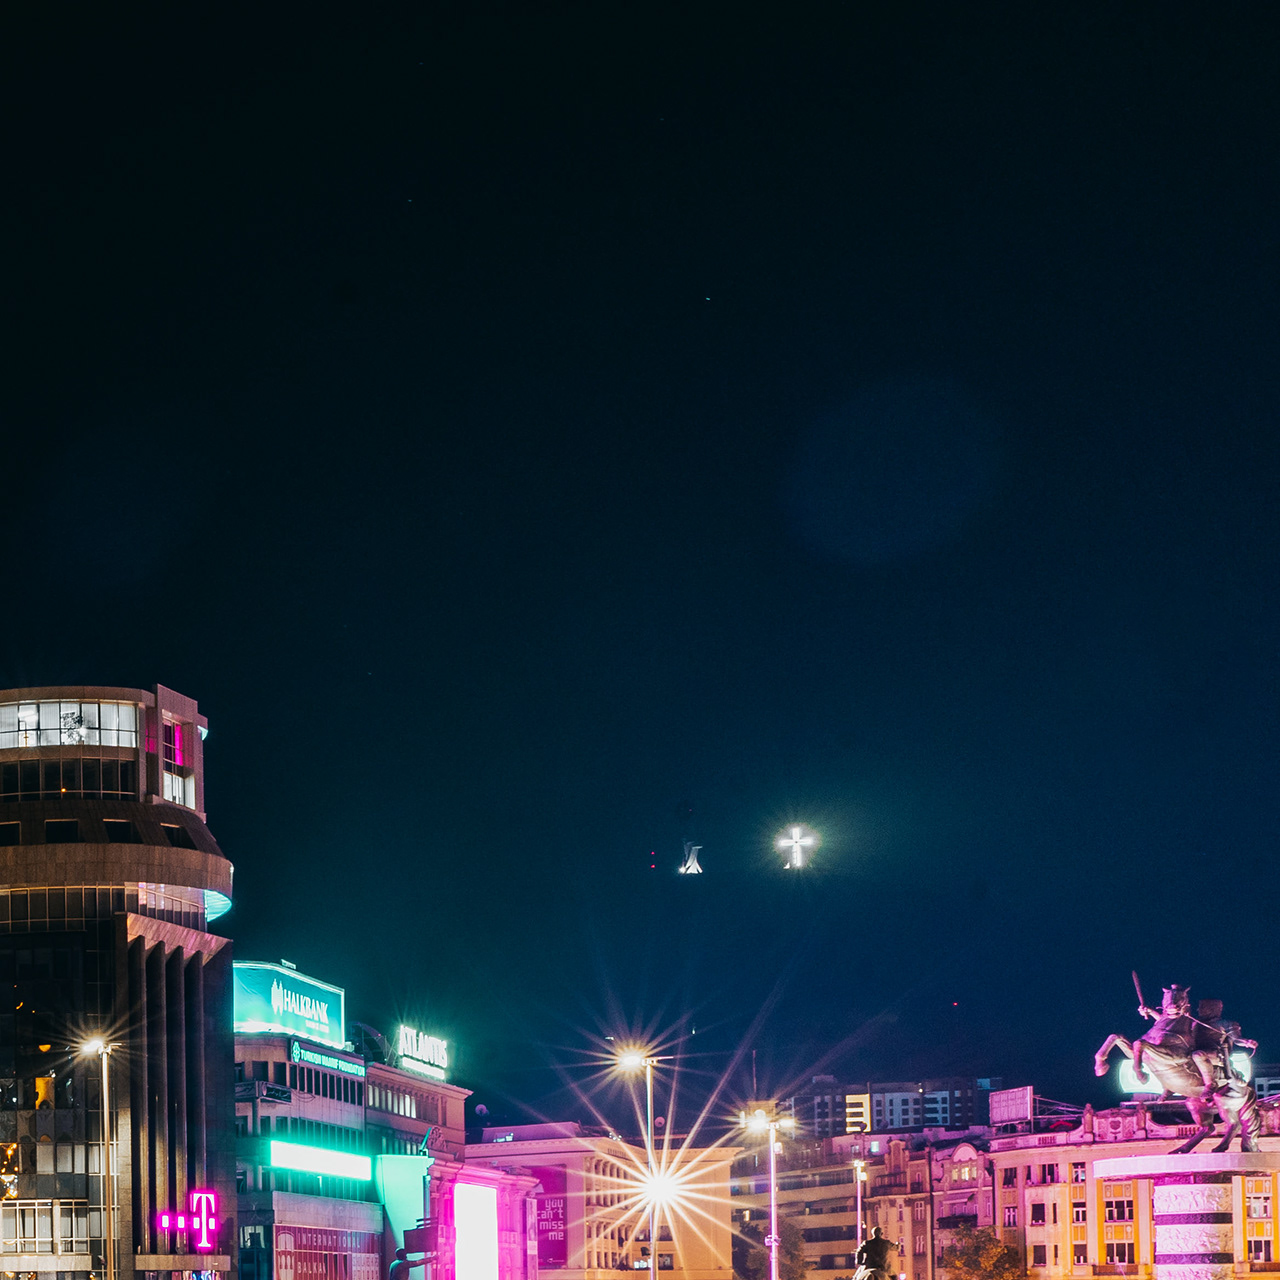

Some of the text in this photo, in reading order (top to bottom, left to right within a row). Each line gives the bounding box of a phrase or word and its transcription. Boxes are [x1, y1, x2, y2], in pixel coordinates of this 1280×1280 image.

[284, 988, 329, 1024] HALKBANK
[398, 1024, 448, 1068] ATLANTIS
[545, 1199, 564, 1211] you
[539, 1219, 564, 1230] miss
[298, 1232, 360, 1249] INTERNATIONAL
[548, 1231, 564, 1241] me
